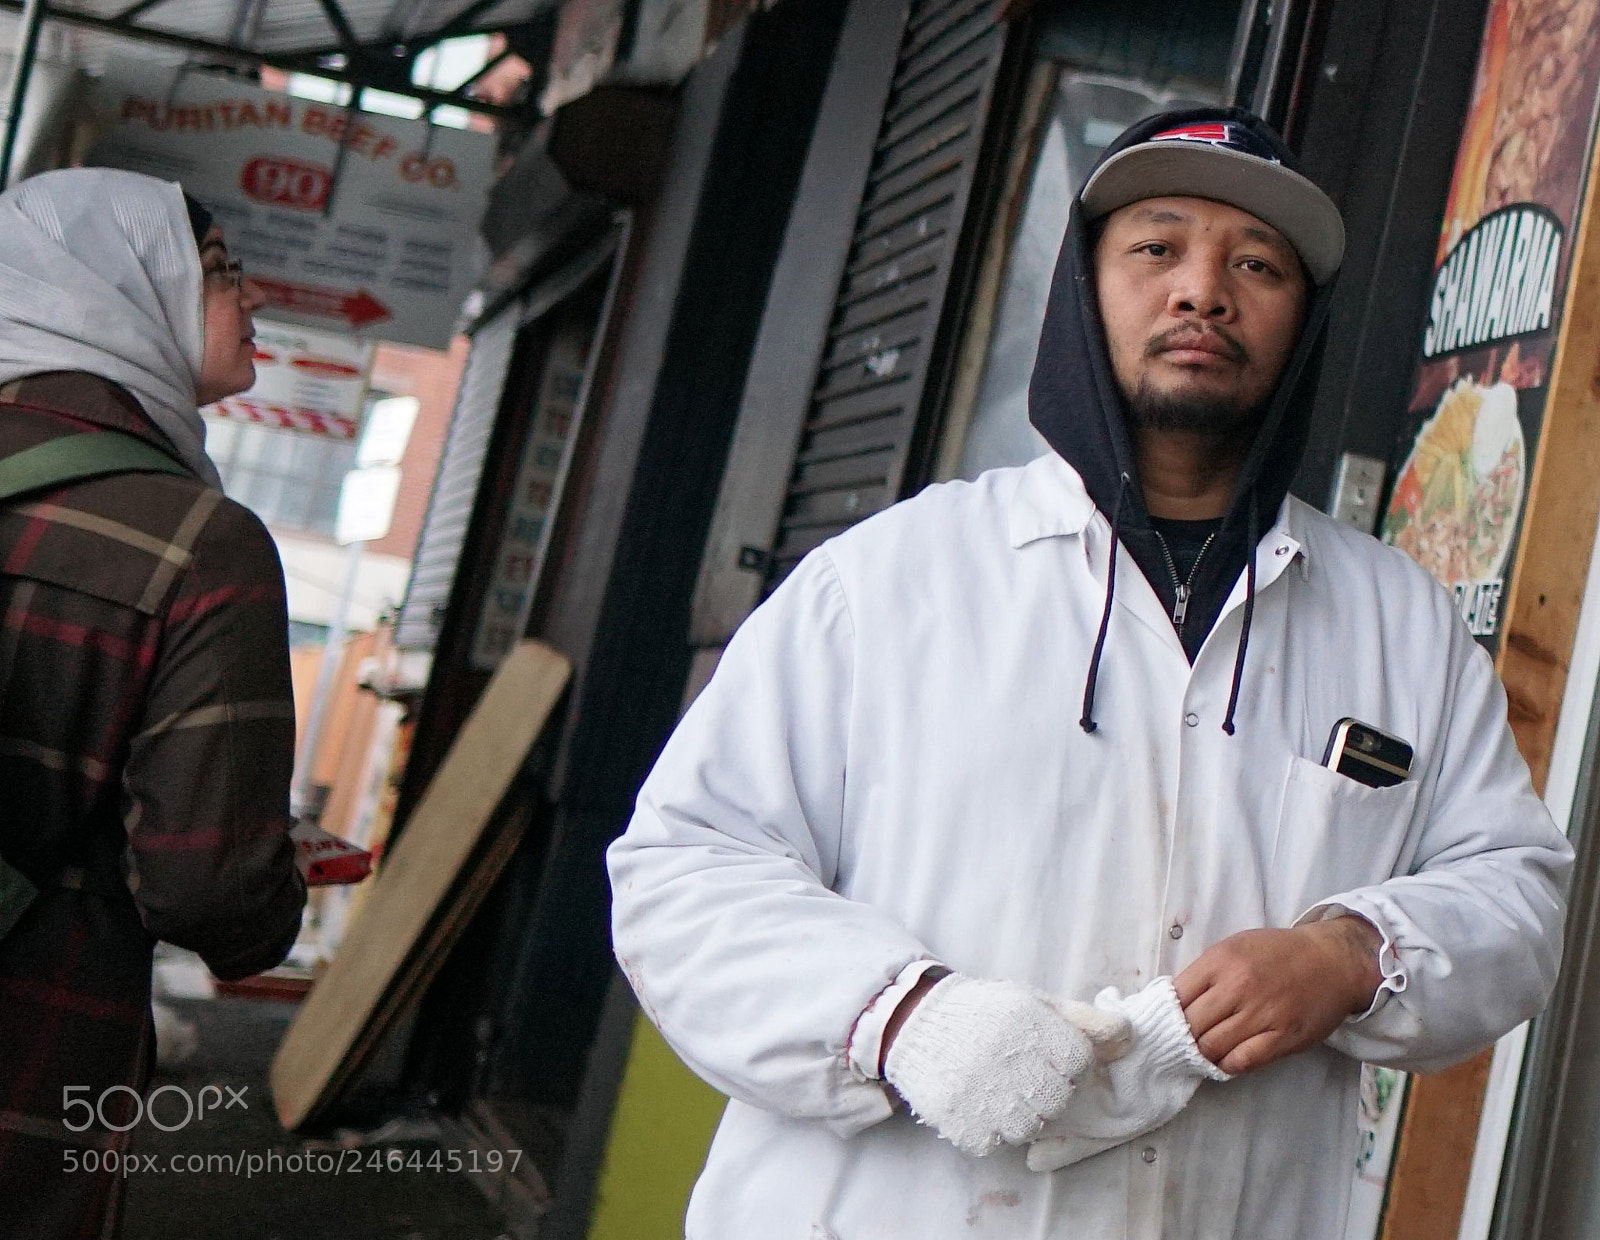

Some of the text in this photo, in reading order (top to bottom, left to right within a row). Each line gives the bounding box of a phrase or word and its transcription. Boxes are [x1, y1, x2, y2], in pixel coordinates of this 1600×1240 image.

[120, 96, 292, 132] PURITAN
[303, 106, 398, 161] BEEF
[1424, 210, 1560, 357] SHAWARMA
